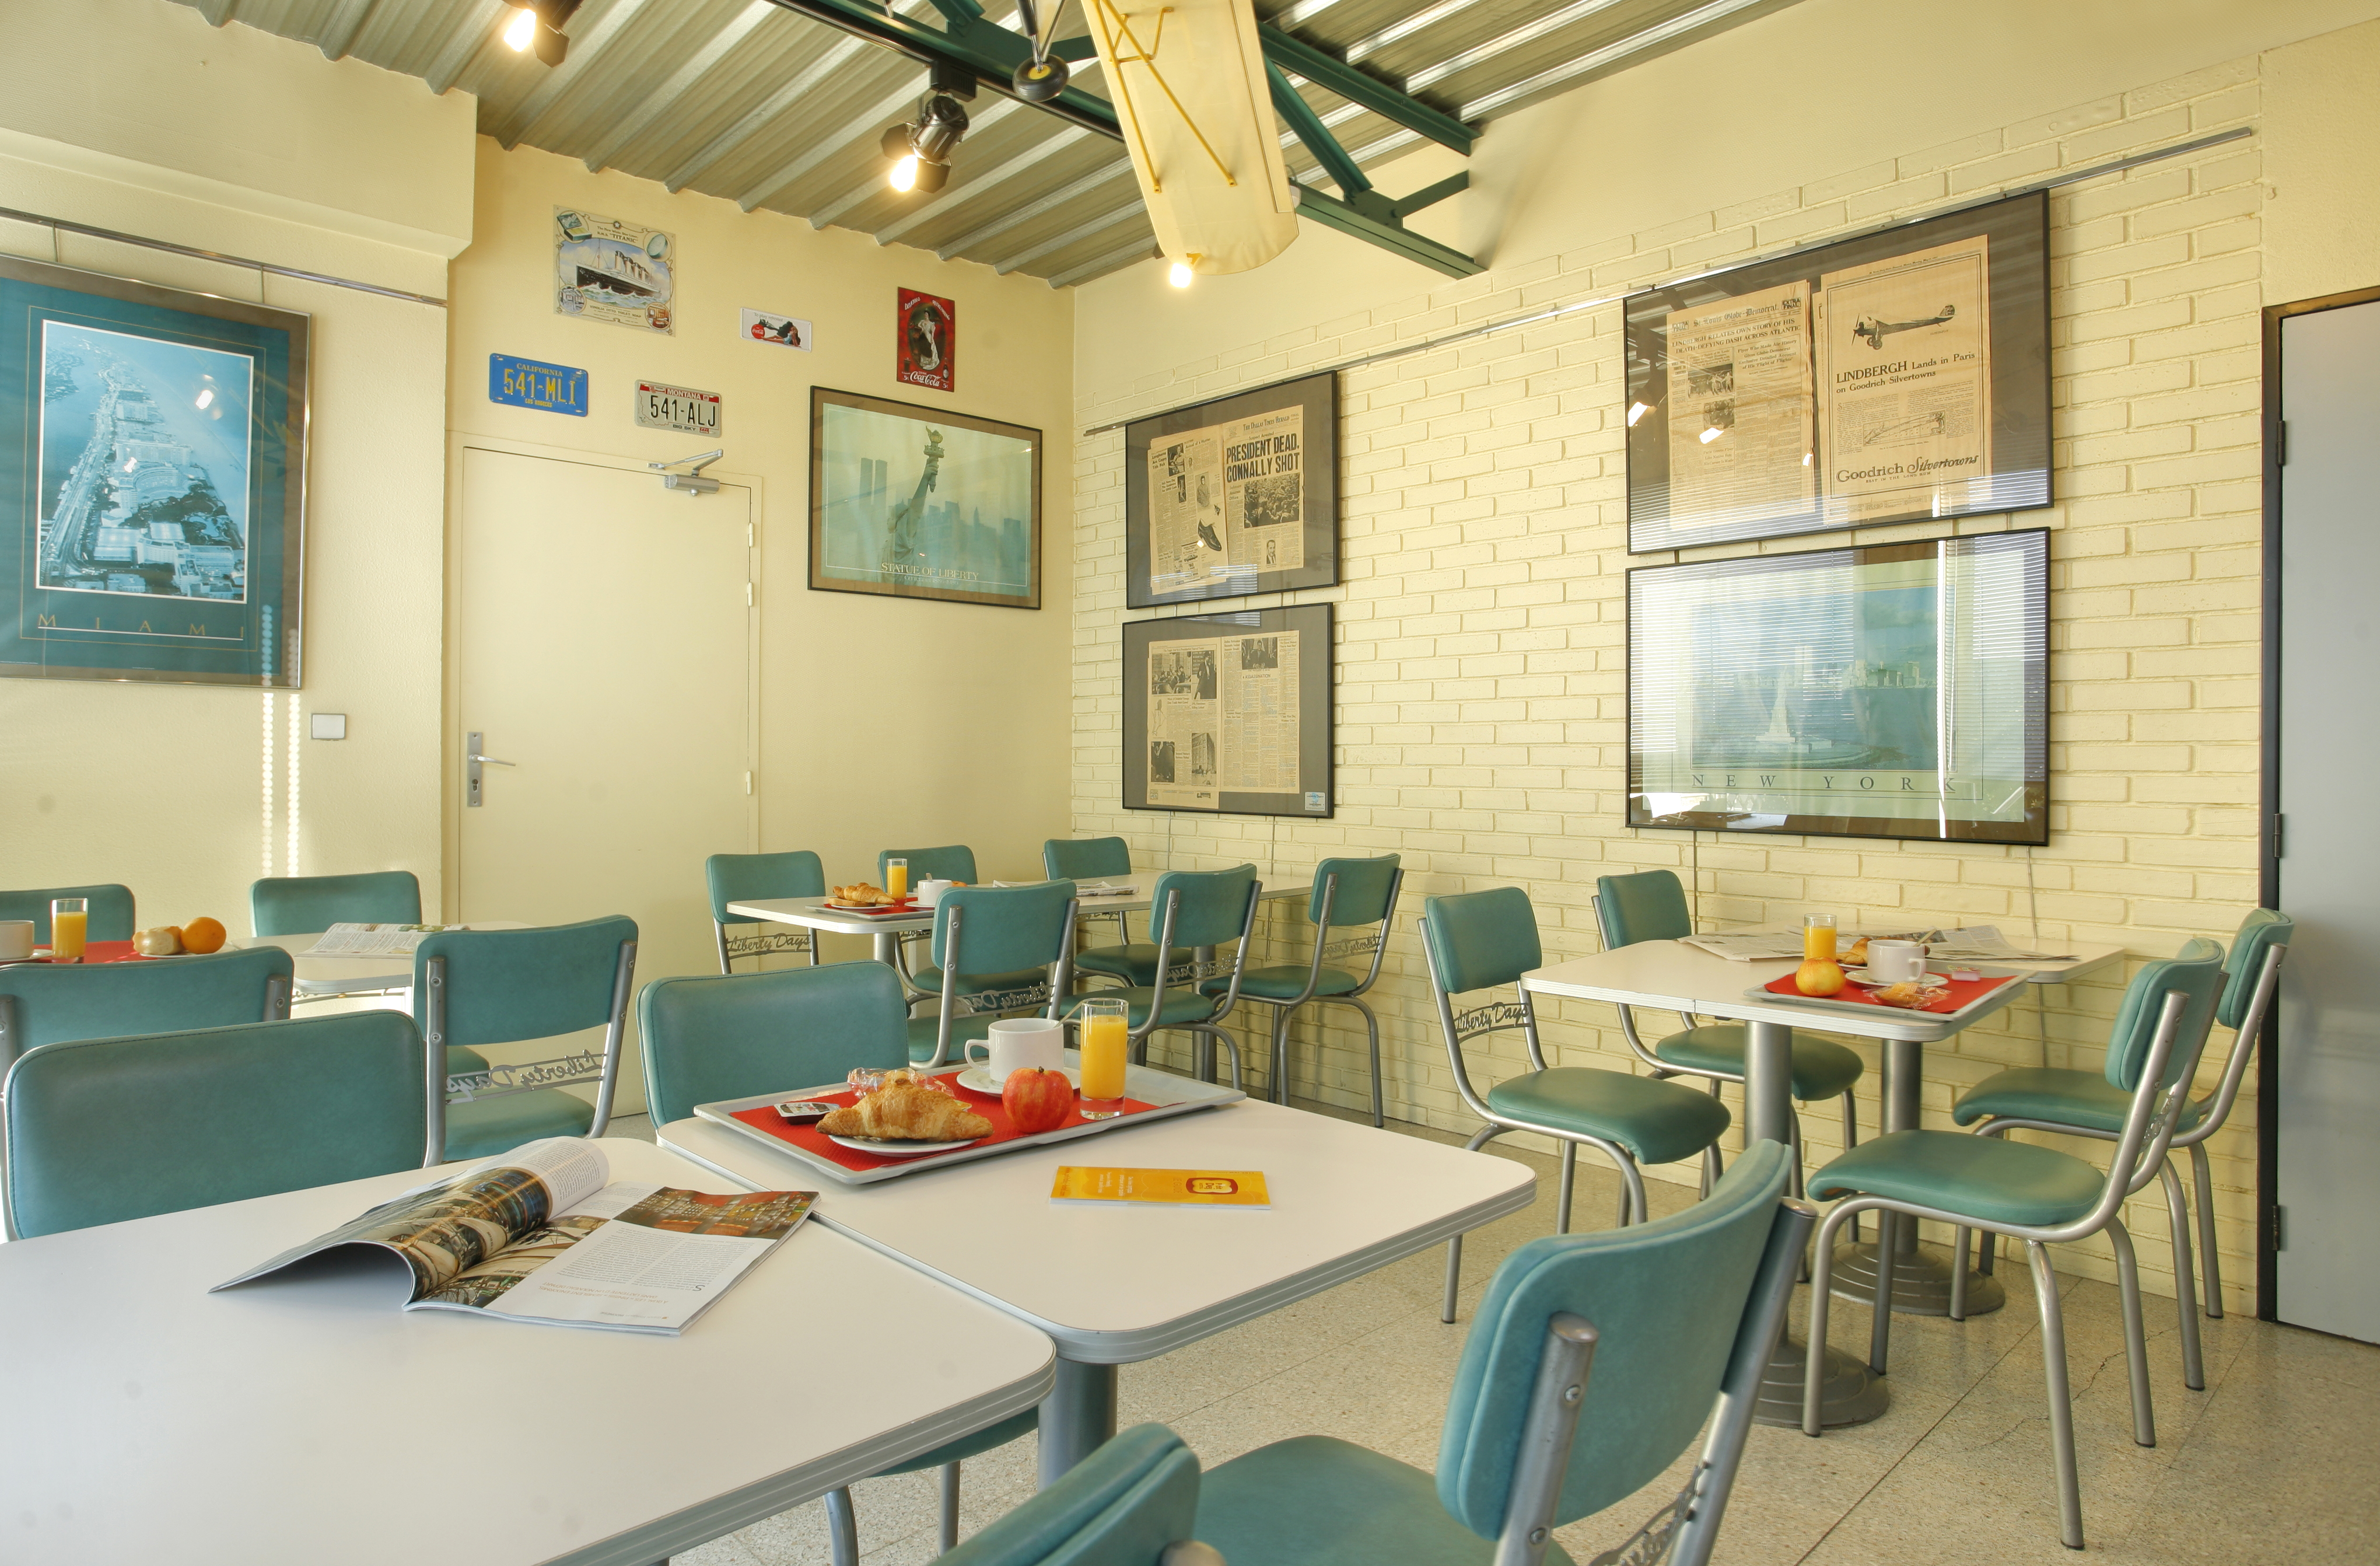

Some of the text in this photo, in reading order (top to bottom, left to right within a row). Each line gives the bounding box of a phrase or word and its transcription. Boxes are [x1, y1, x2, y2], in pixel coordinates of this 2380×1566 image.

[1672, 335, 1706, 347] LINDBERGH
[1708, 330, 1735, 340] RELATES
[1752, 323, 1772, 332] STORY
[1726, 335, 1742, 345] DASH
[1744, 331, 1768, 341] ACROSS
[1769, 324, 1801, 337] ATLANTIC
[516, 363, 563, 377] CALIFORNIA
[1836, 351, 1975, 383] LINDBERGH Lands in Paris
[503, 368, 576, 404] 541-MLI
[1849, 379, 1885, 391] Goodrich
[1889, 370, 1936, 384] Silvertowns
[667, 389, 701, 400] MONTANA
[650, 395, 715, 427] 541-ALJ
[1226, 438, 1272, 464] PRESIDENT
[1227, 452, 1300, 483] CONNALLY SHOT
[1836, 455, 1979, 483] Goodrich Silvertowns
[881, 562, 920, 575] STATUE
[922, 567, 936, 576] OF
[939, 568, 979, 581] LIBERTY
[38, 613, 244, 637] MIAMI
[1692, 774, 1956, 792] NEW YORK
[727, 933, 811, 952] Liberty Days
[1455, 1002, 1529, 1033] Liberty Days
